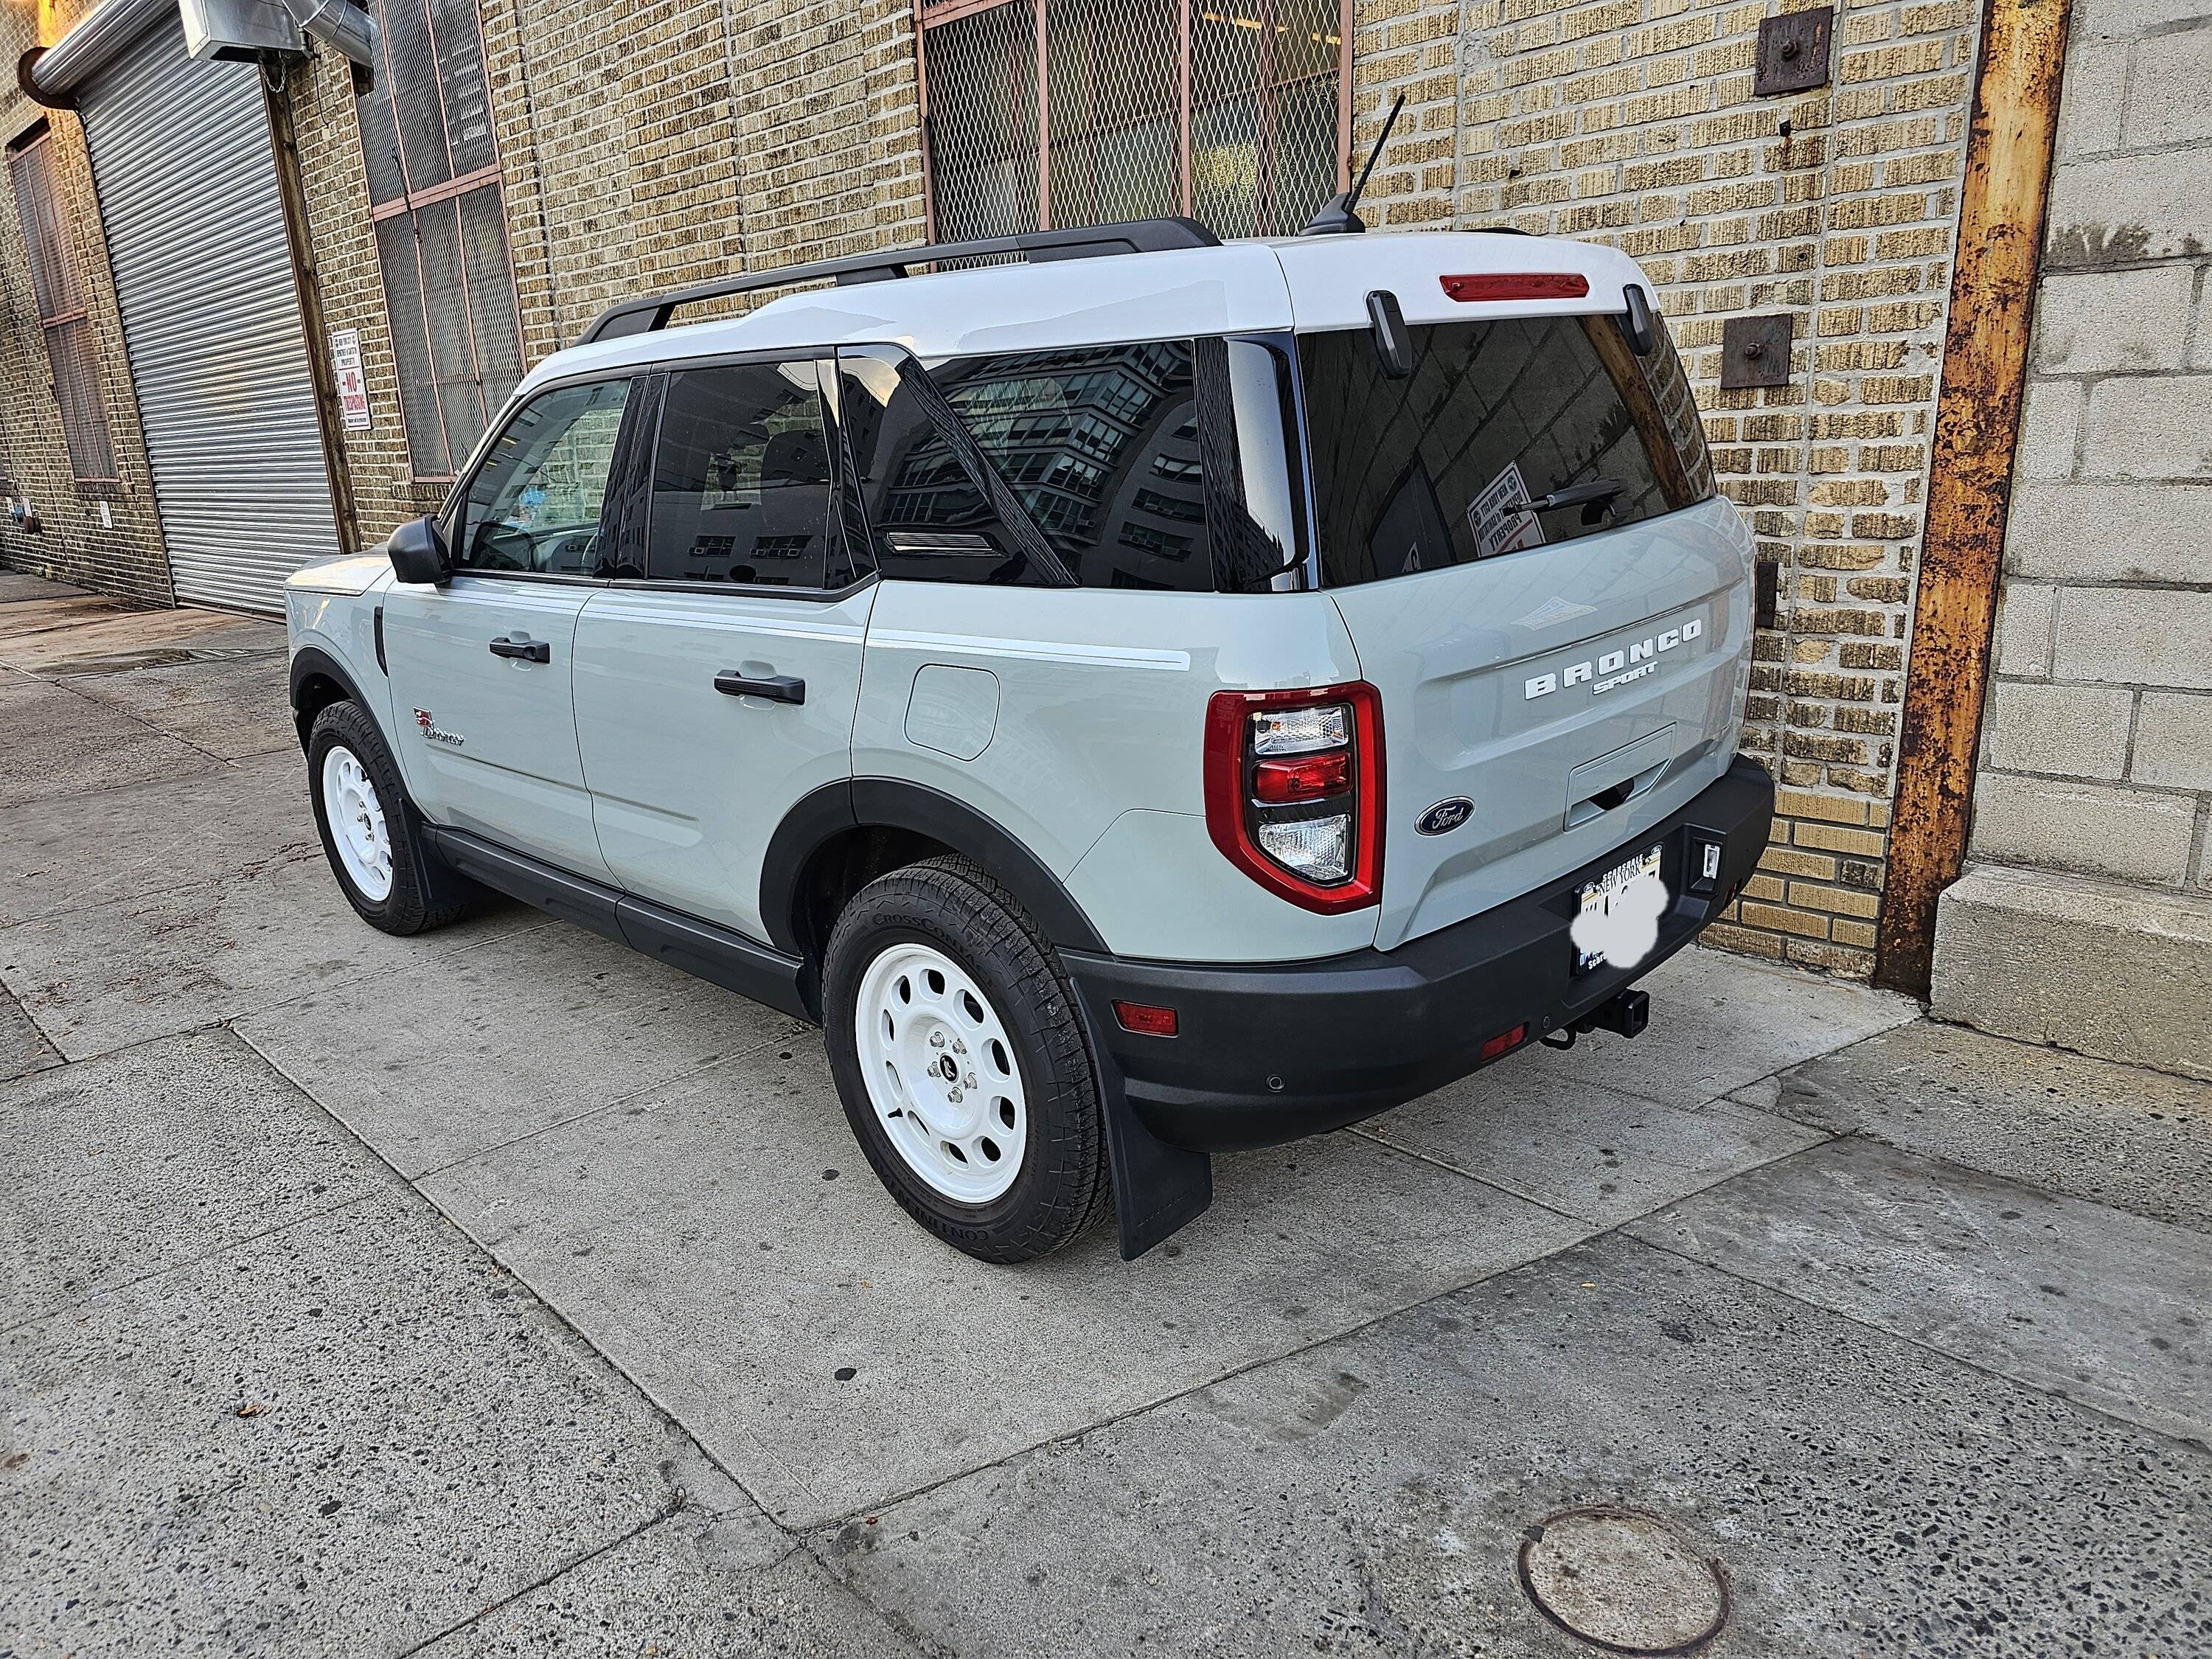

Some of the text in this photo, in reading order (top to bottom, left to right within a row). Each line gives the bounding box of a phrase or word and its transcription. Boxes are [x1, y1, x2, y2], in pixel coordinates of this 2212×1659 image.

[345, 372, 358, 392] NO
[1524, 619, 1702, 700] BRONCO
[1591, 661, 1658, 695] SPORT
[1432, 805, 1464, 830] Ford
[1599, 877, 1617, 896] NEW
[1619, 864, 1641, 883] YORK
[1602, 854, 1644, 883] SCARSDALE
